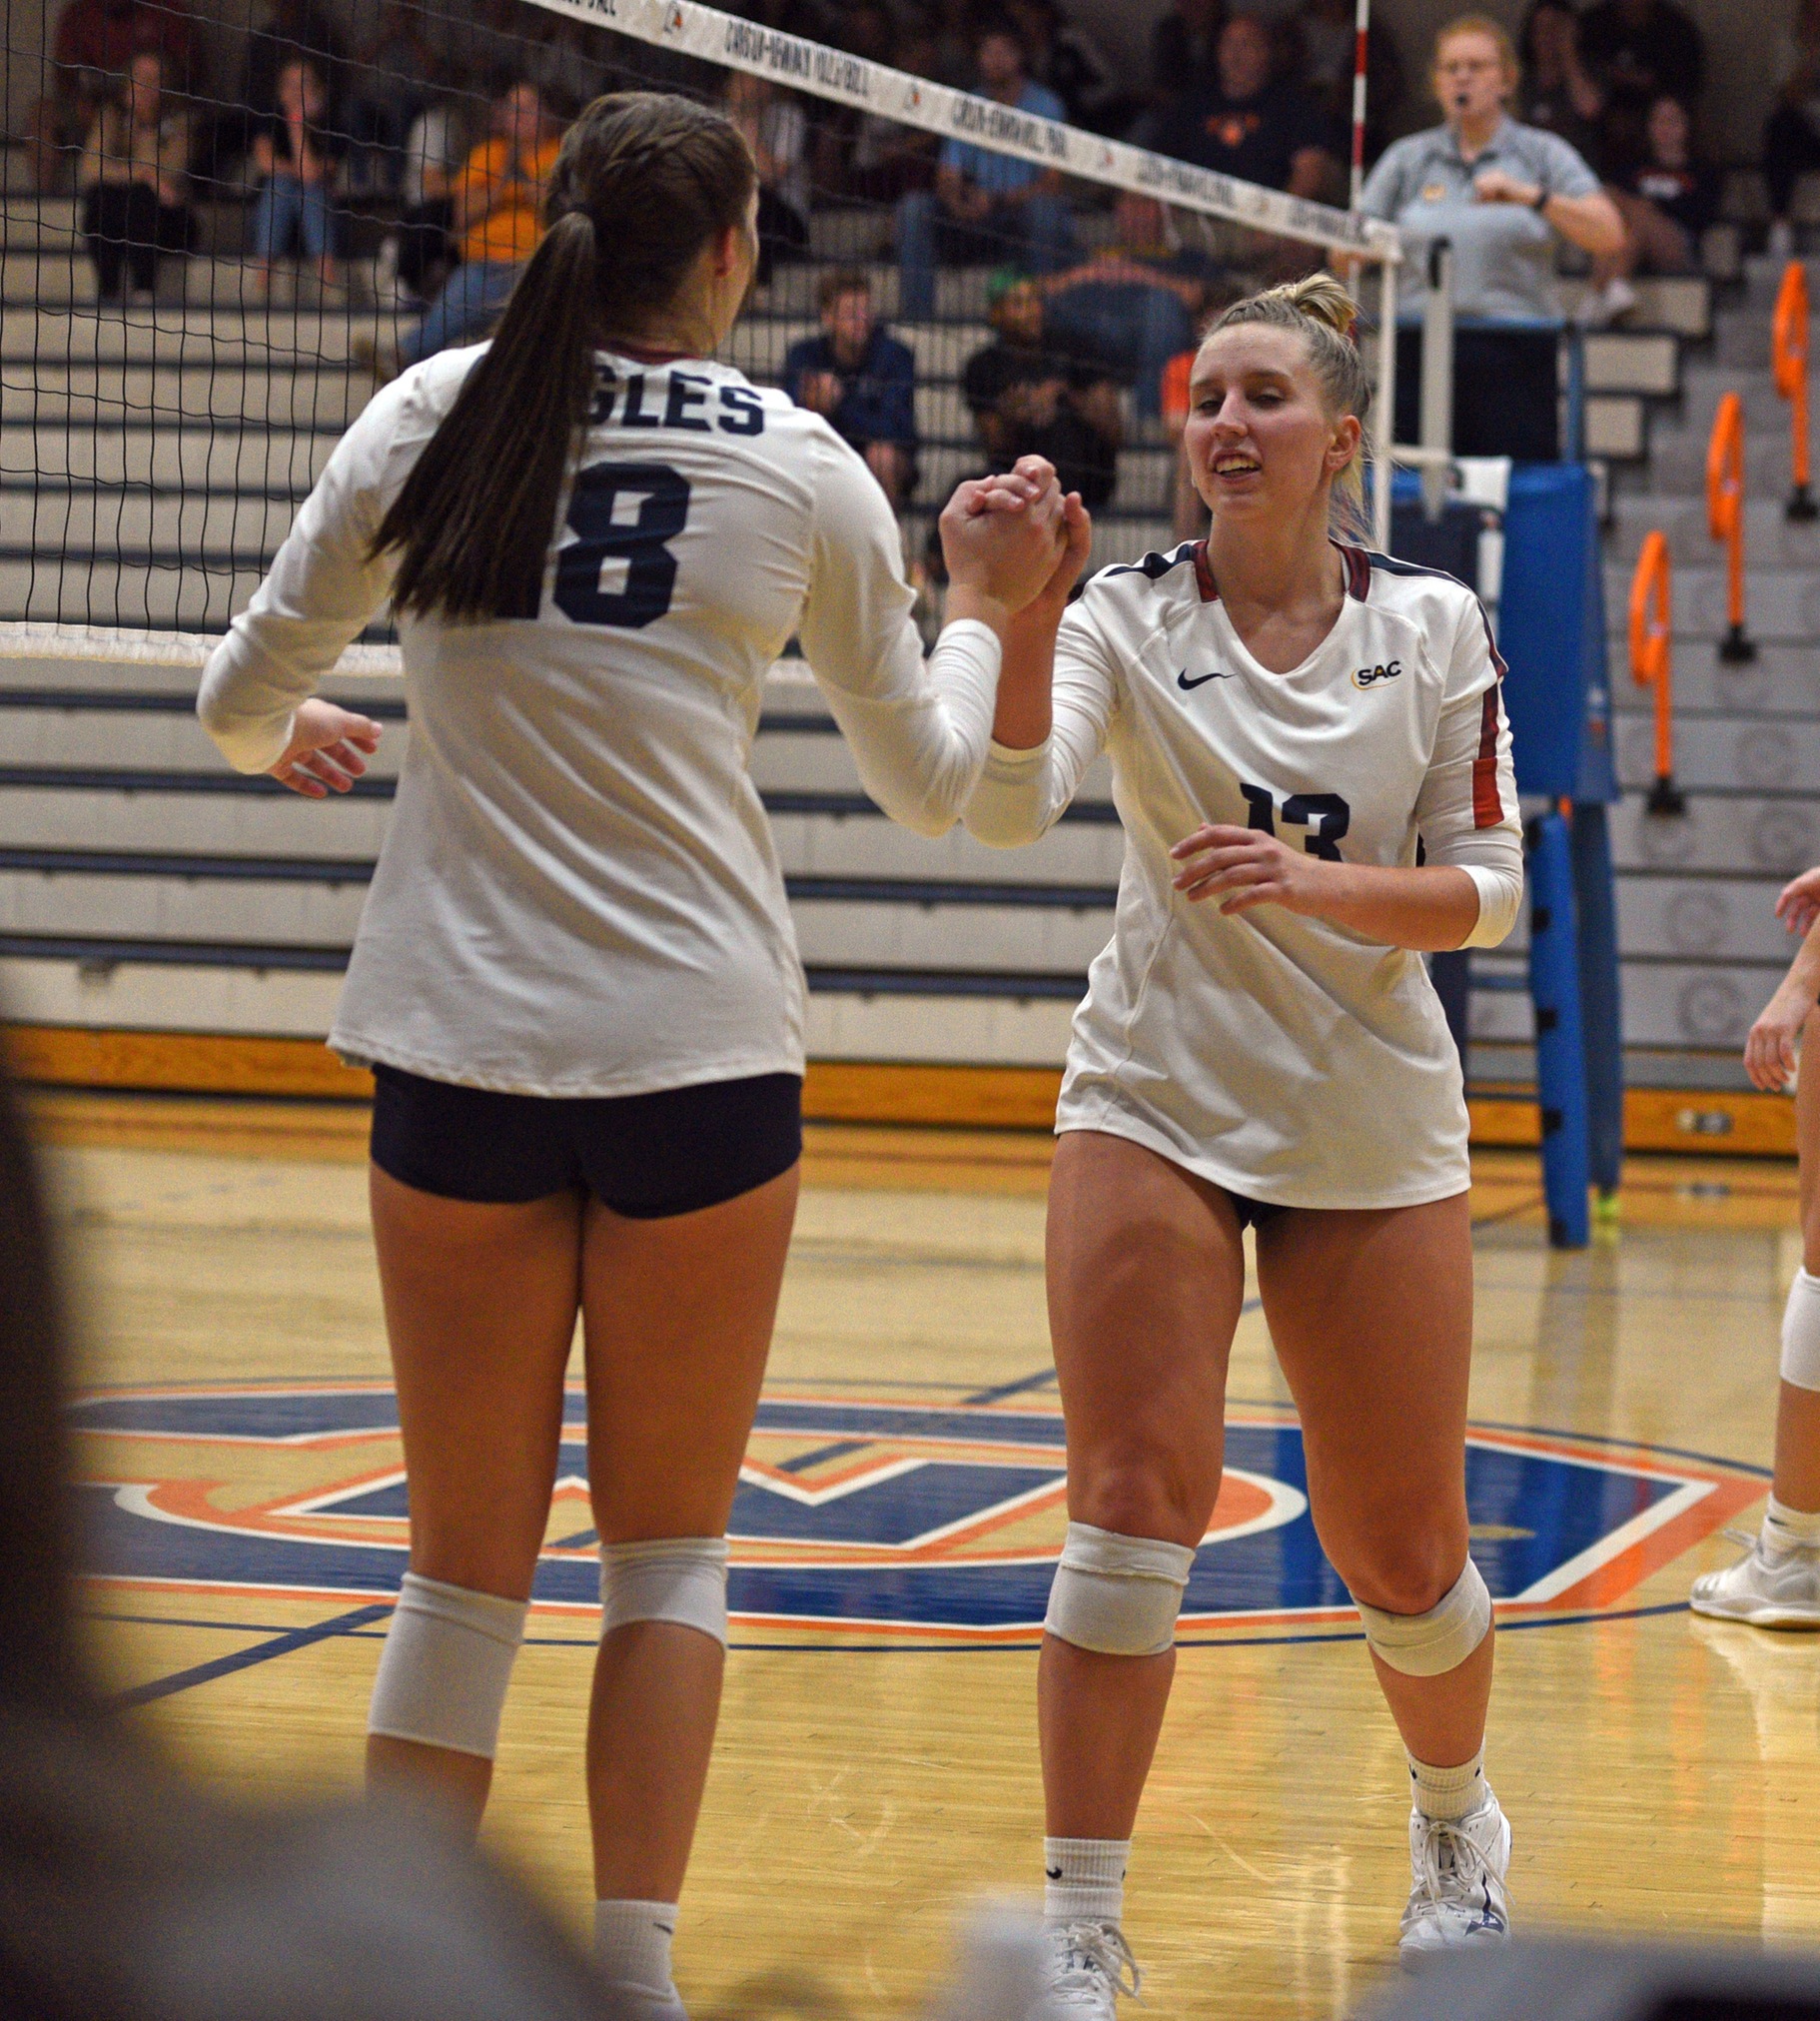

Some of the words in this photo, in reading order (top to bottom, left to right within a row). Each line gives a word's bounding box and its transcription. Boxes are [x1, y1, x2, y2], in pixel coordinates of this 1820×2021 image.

[588, 361, 765, 437] GLES
[1358, 660, 1402, 686] SAC
[1240, 782, 1351, 862] 13
